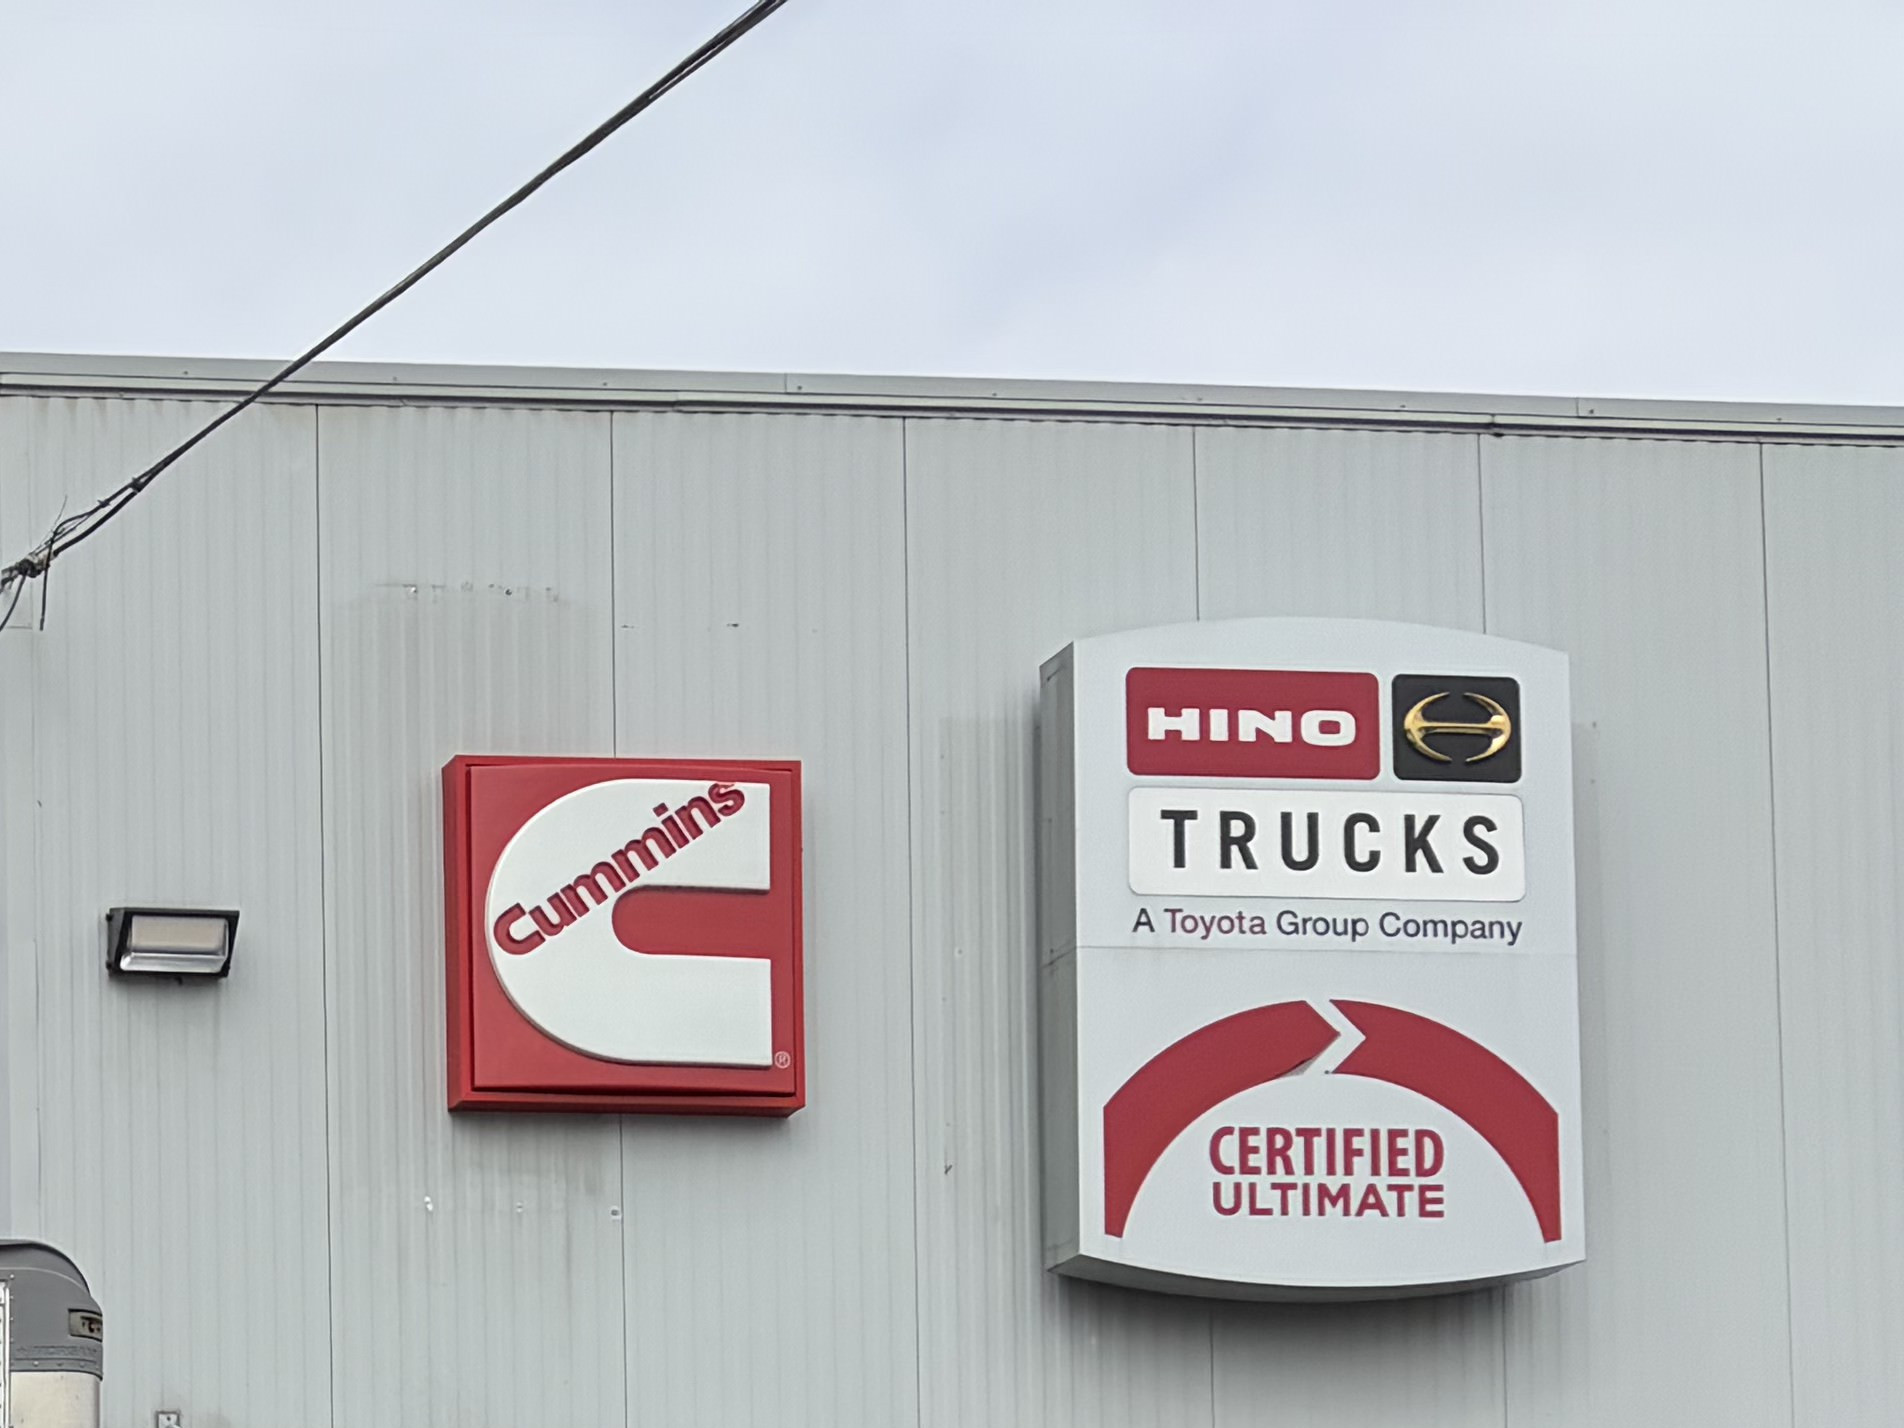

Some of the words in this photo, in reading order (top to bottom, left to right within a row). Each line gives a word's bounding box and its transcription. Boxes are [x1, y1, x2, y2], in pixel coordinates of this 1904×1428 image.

[1147, 707, 1357, 747] HINO
[1160, 809, 1501, 875] TRUCKS
[493, 782, 747, 956] Cummins
[1131, 907, 1156, 933] A
[1163, 908, 1268, 941] Toyota
[1275, 909, 1370, 943] Group
[1378, 911, 1524, 947] Company
[1208, 1125, 1445, 1178] CERTIFIED
[1212, 1181, 1445, 1219] ULTIMATE
